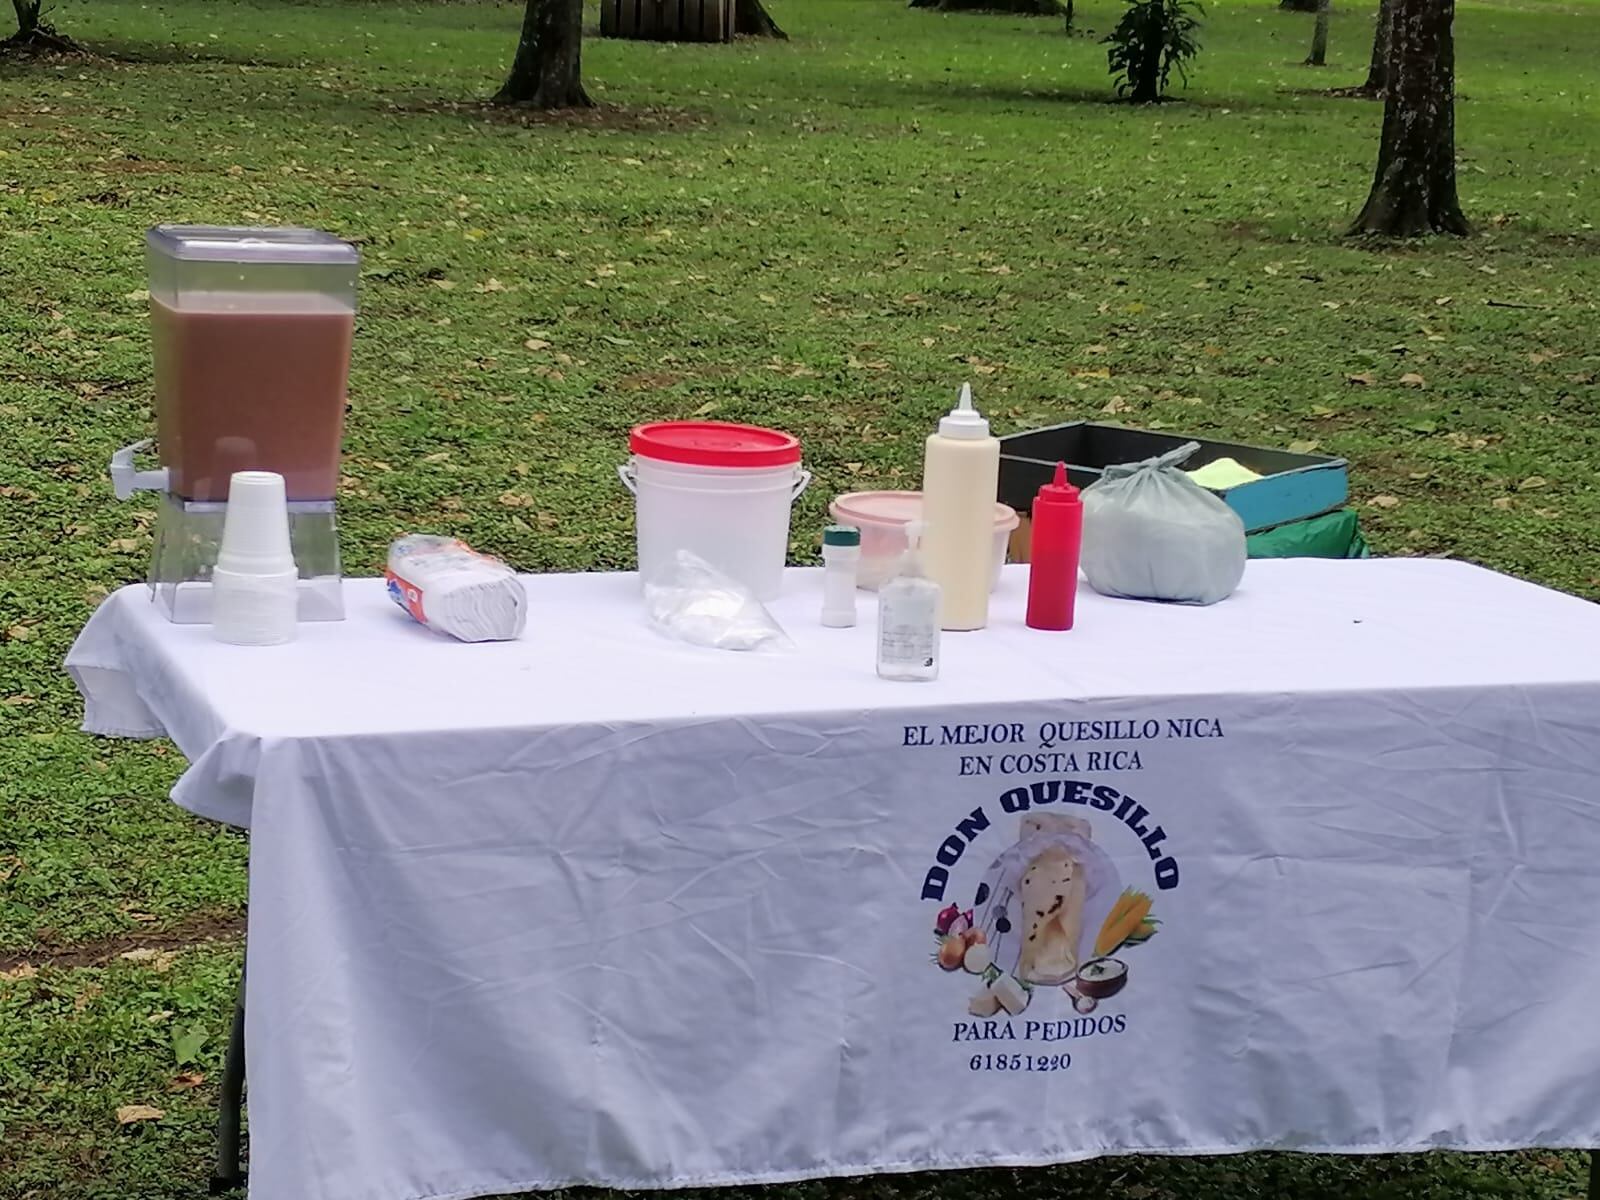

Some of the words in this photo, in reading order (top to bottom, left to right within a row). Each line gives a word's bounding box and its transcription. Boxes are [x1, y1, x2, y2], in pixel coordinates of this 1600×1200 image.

[903, 725, 934, 746] EL
[942, 723, 1025, 744] MEJOR
[1039, 720, 1159, 748] QUESILLO
[1167, 718, 1225, 738] NICA
[958, 756, 992, 776] EN
[1000, 753, 1079, 774] COSTA
[1087, 751, 1144, 771] RICA
[921, 806, 991, 901] DON
[999, 780, 1179, 890] QUESILLO
[952, 1021, 1016, 1042] PARA
[1024, 1014, 1127, 1042] PEDIDOS
